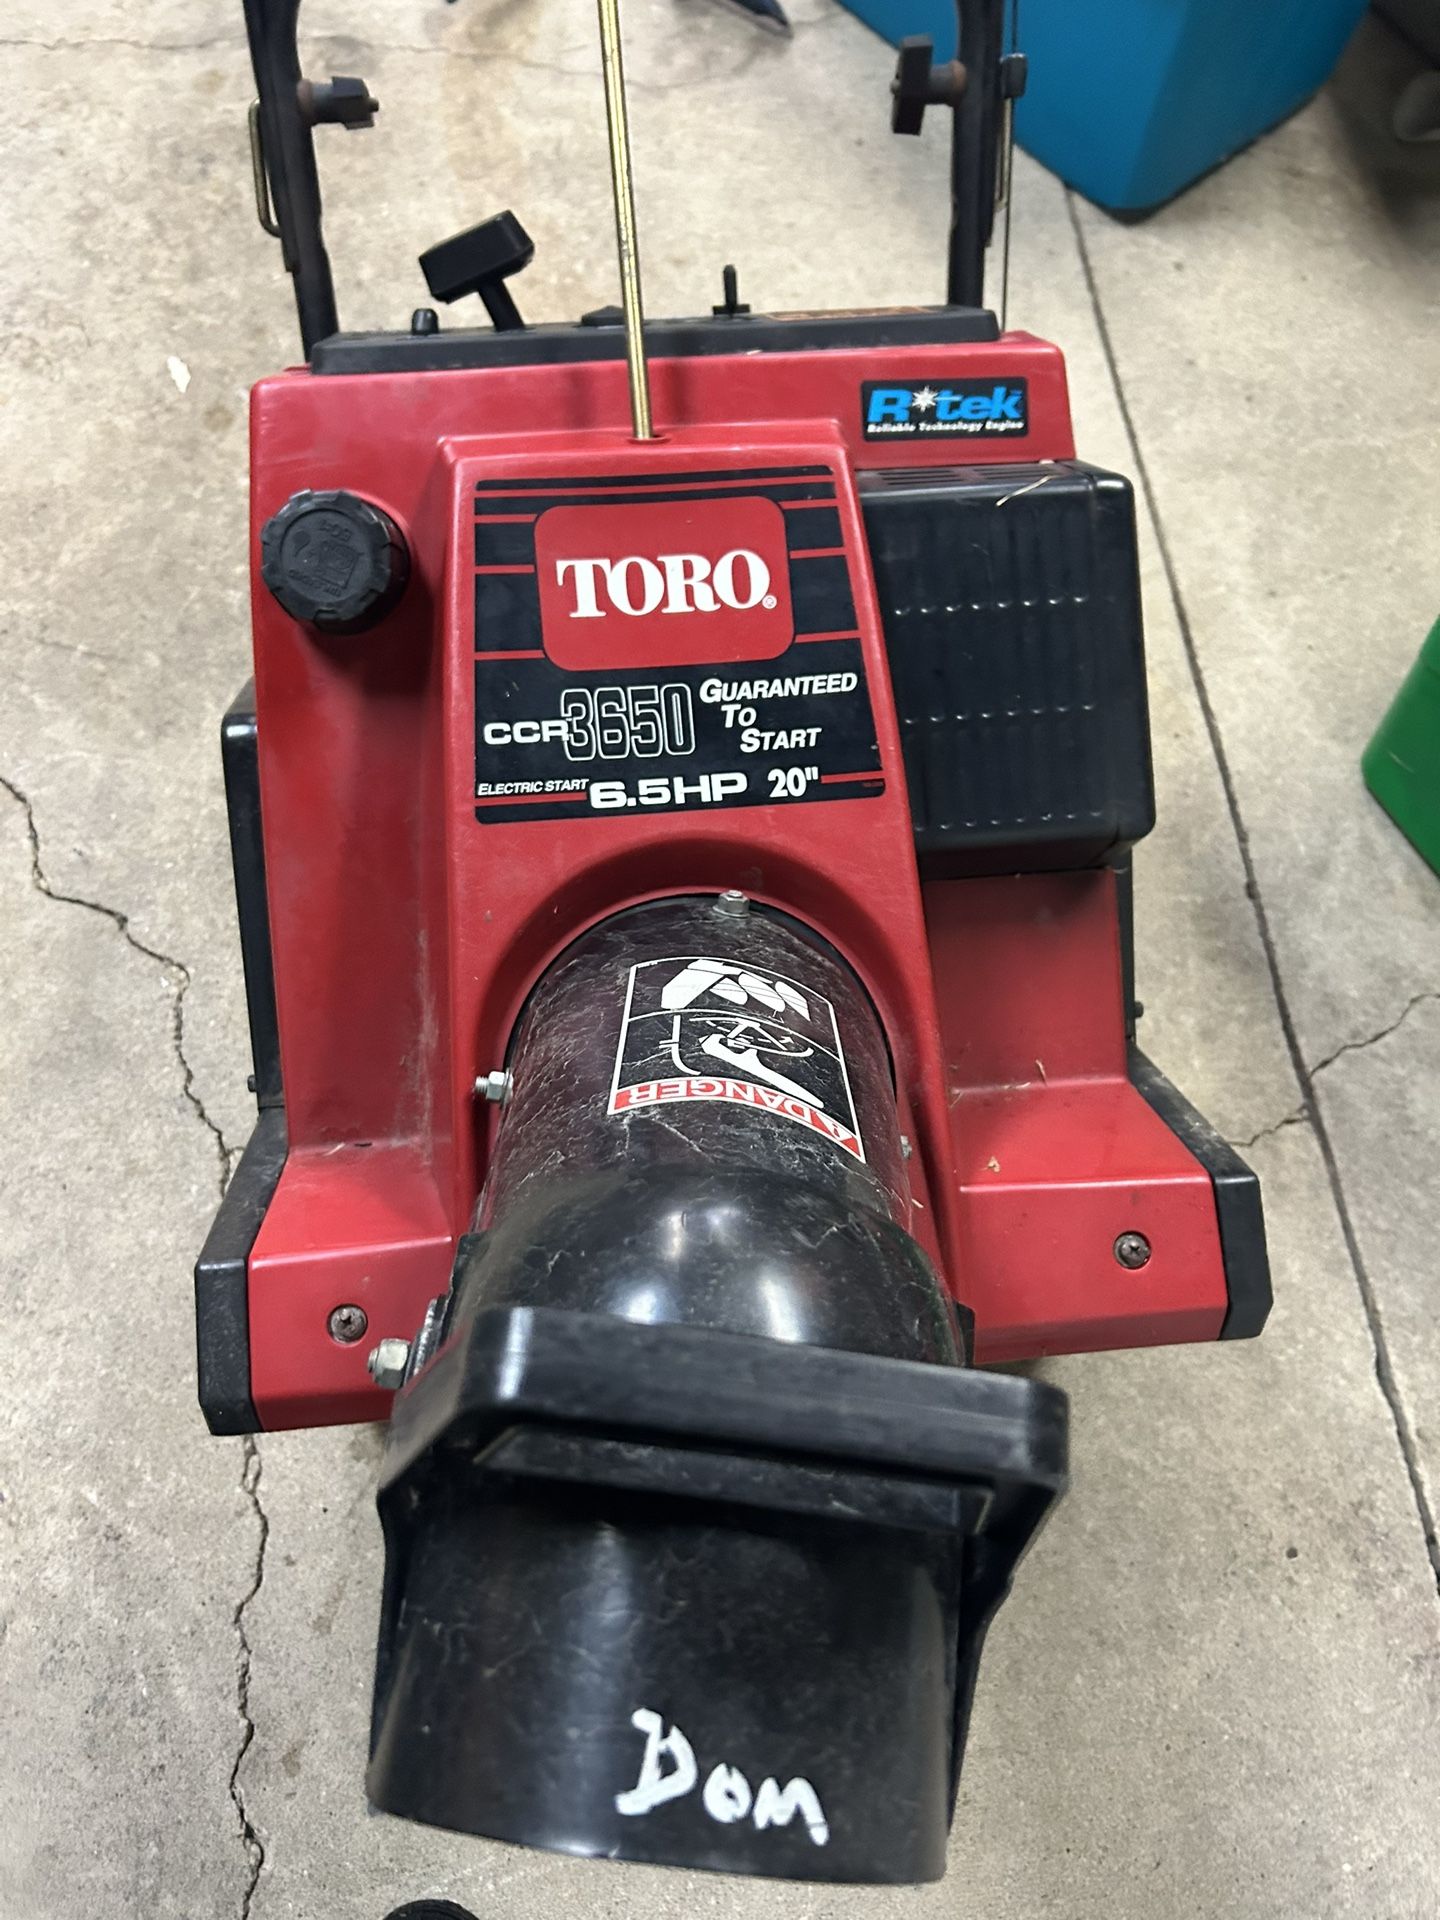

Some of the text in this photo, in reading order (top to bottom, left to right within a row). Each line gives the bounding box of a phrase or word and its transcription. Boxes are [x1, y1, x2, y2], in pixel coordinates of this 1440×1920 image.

[867, 420, 1025, 433] Reliable Technology Engine
[484, 683, 696, 761] CCR 3650
[545, 778, 590, 792] START
[589, 772, 748, 809] 6.5HP
[767, 766, 819, 798] 20"
[629, 1079, 815, 1125] DANGER
